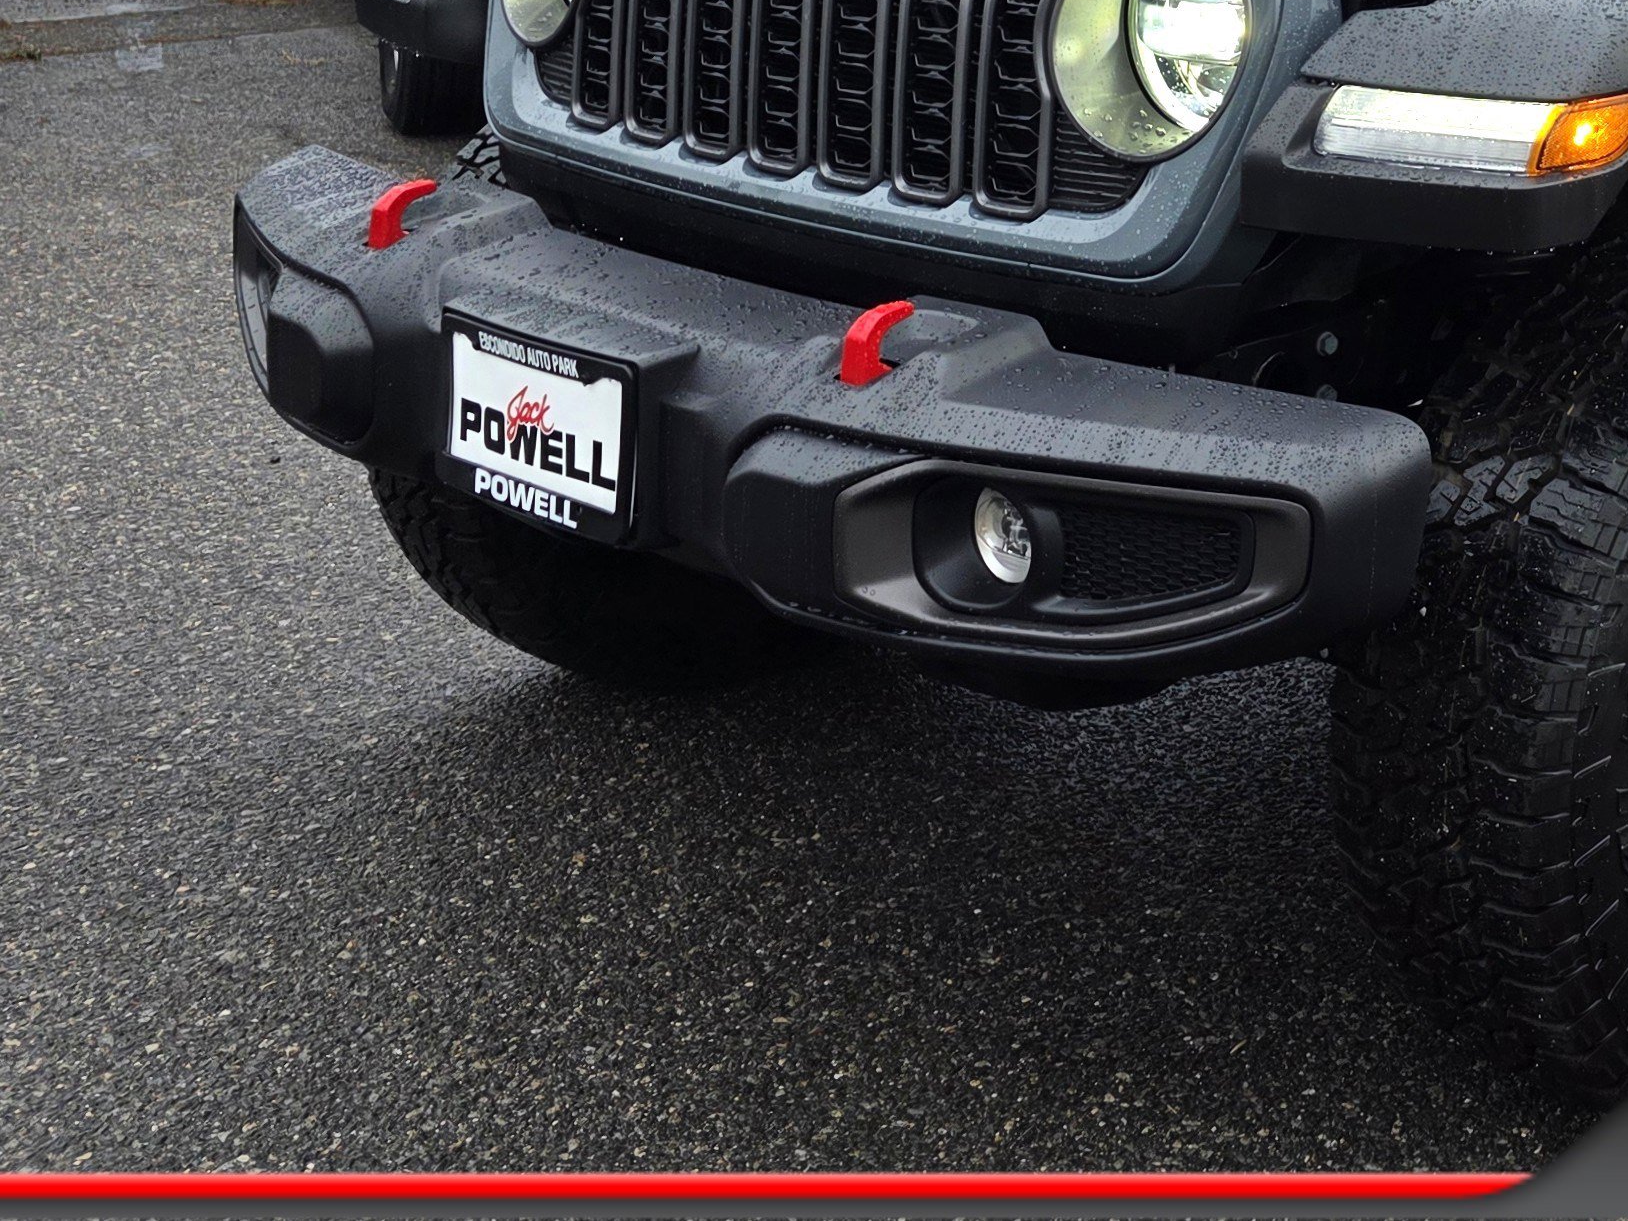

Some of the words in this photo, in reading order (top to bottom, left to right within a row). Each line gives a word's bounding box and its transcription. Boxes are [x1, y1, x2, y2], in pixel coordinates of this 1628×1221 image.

[478, 331, 526, 365] ESCONDIDO
[527, 347, 551, 372] AUTO
[552, 353, 579, 379] PARK
[507, 385, 554, 443] Jack
[459, 397, 617, 492] POWELL
[474, 467, 578, 530] POWELL
